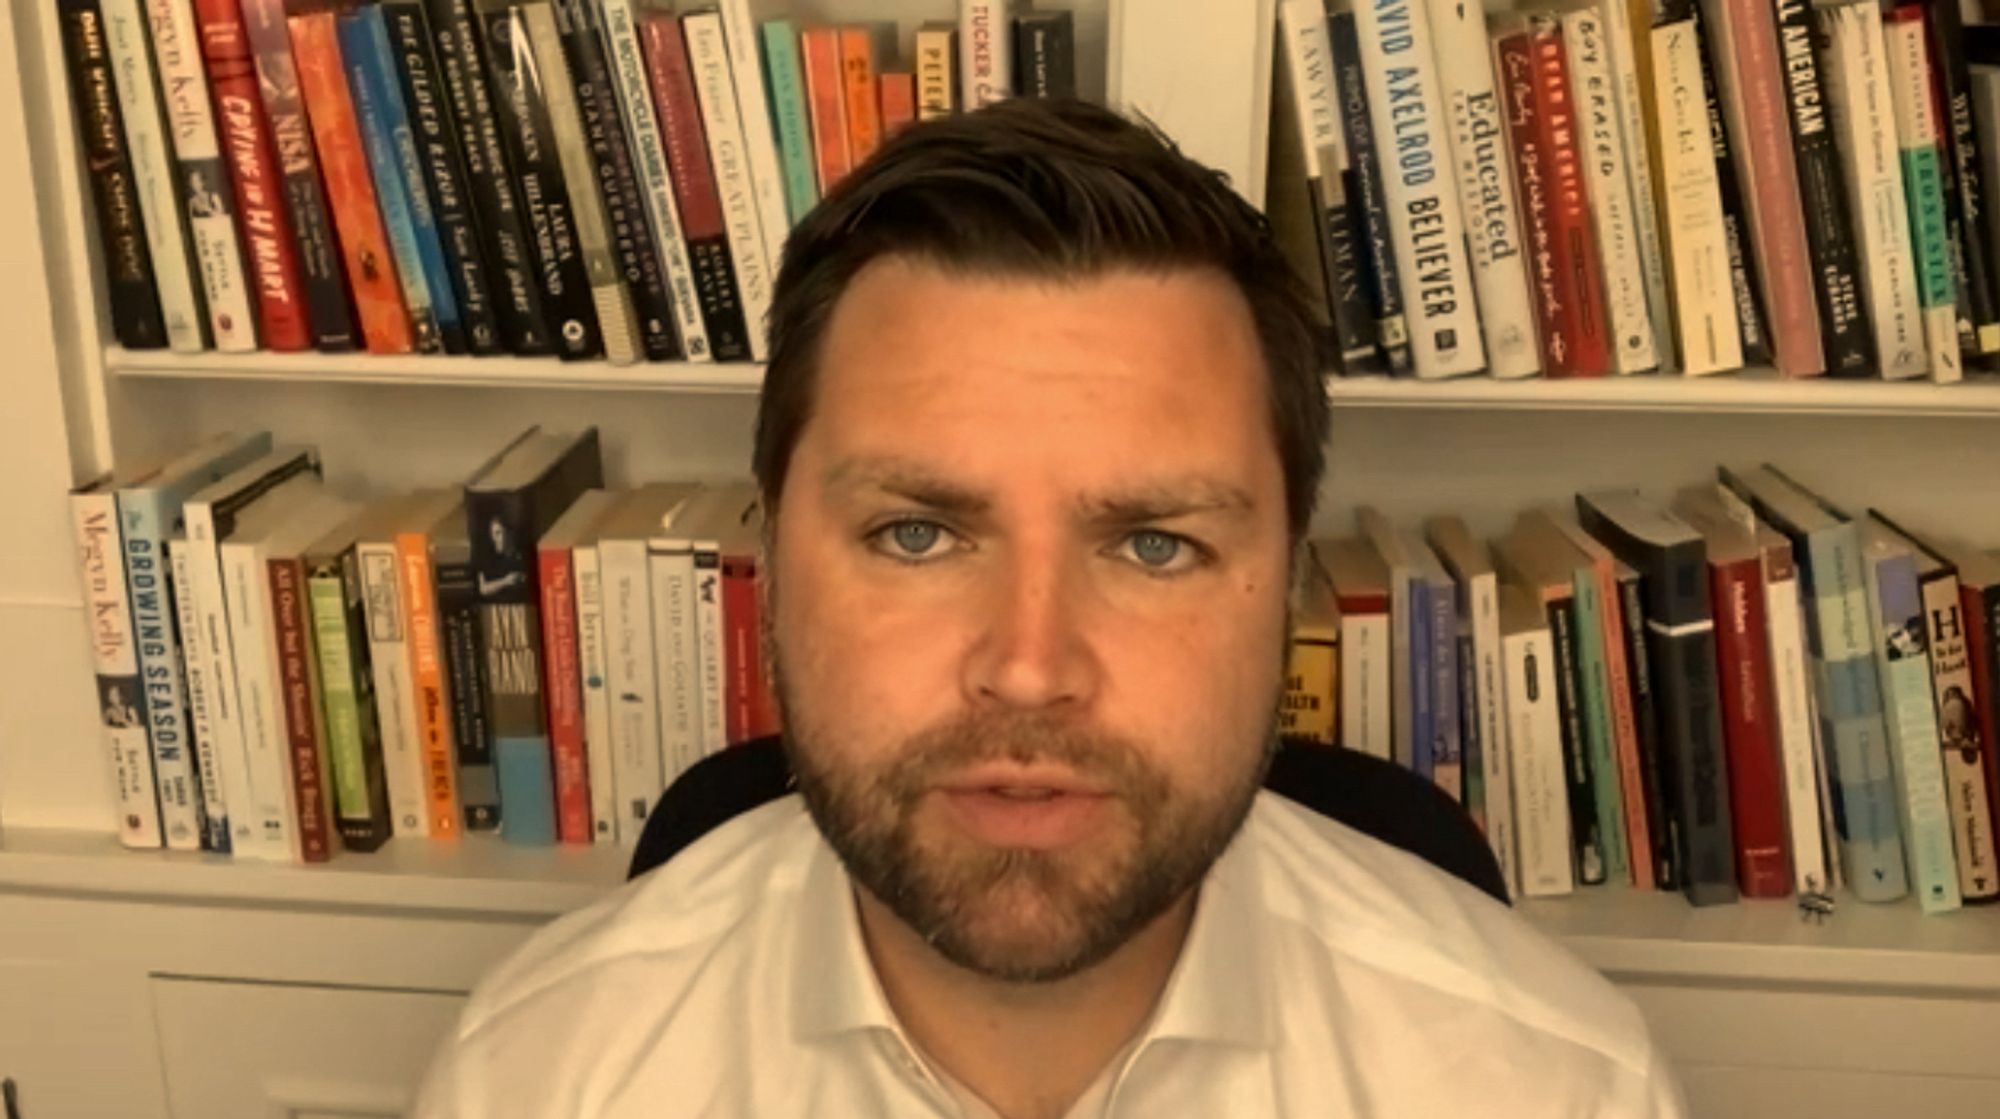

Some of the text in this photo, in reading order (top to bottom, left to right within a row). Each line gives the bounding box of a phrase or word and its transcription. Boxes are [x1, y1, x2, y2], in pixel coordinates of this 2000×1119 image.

[397, 14, 417, 47] THE
[609, 6, 628, 34] THE
[697, 26, 717, 58] Ian
[970, 5, 990, 76] TUCKER
[169, 72, 205, 140] Kelly
[406, 52, 439, 136] GILDED
[437, 30, 484, 173] OF ROBERT PEACE
[456, 20, 513, 211] SHORT AND TRAGIC LIFE
[616, 37, 652, 129] MOTORCYCLE
[1300, 26, 1334, 136] LAWYER
[1578, 21, 1615, 175] BOY ERASED
[1782, 24, 1824, 134] AMERICAN
[221, 93, 265, 179] CRYING
[272, 110, 310, 173] NISA
[639, 133, 665, 187] DIARIES
[1383, 64, 1438, 185] AXELROD
[429, 141, 456, 206] RAZOR
[577, 82, 642, 281] DIANE GUERRERO
[608, 130, 639, 209] COUNTRY
[639, 251, 660, 294] LOVE
[1450, 91, 1492, 270] TARA WESTOVER
[1465, 90, 1519, 263] Educated
[246, 204, 276, 237] H
[522, 173, 562, 295] HILLENBRAND
[548, 202, 573, 260] LAURA
[719, 138, 763, 302] GREAT PLAINS
[1404, 195, 1459, 317] BELIEVER
[253, 233, 288, 306] MART
[695, 244, 719, 312] GRAVES
[709, 243, 733, 310] ROBERT
[78, 511, 126, 661] Megyn Kelly
[127, 536, 166, 656] GROWING
[491, 603, 528, 648] AYN
[1933, 605, 1959, 641] H
[145, 663, 180, 762] SEASON
[488, 648, 538, 694] RAND
[190, 667, 208, 719] ROBERT
[199, 740, 218, 801] KENNEDY
